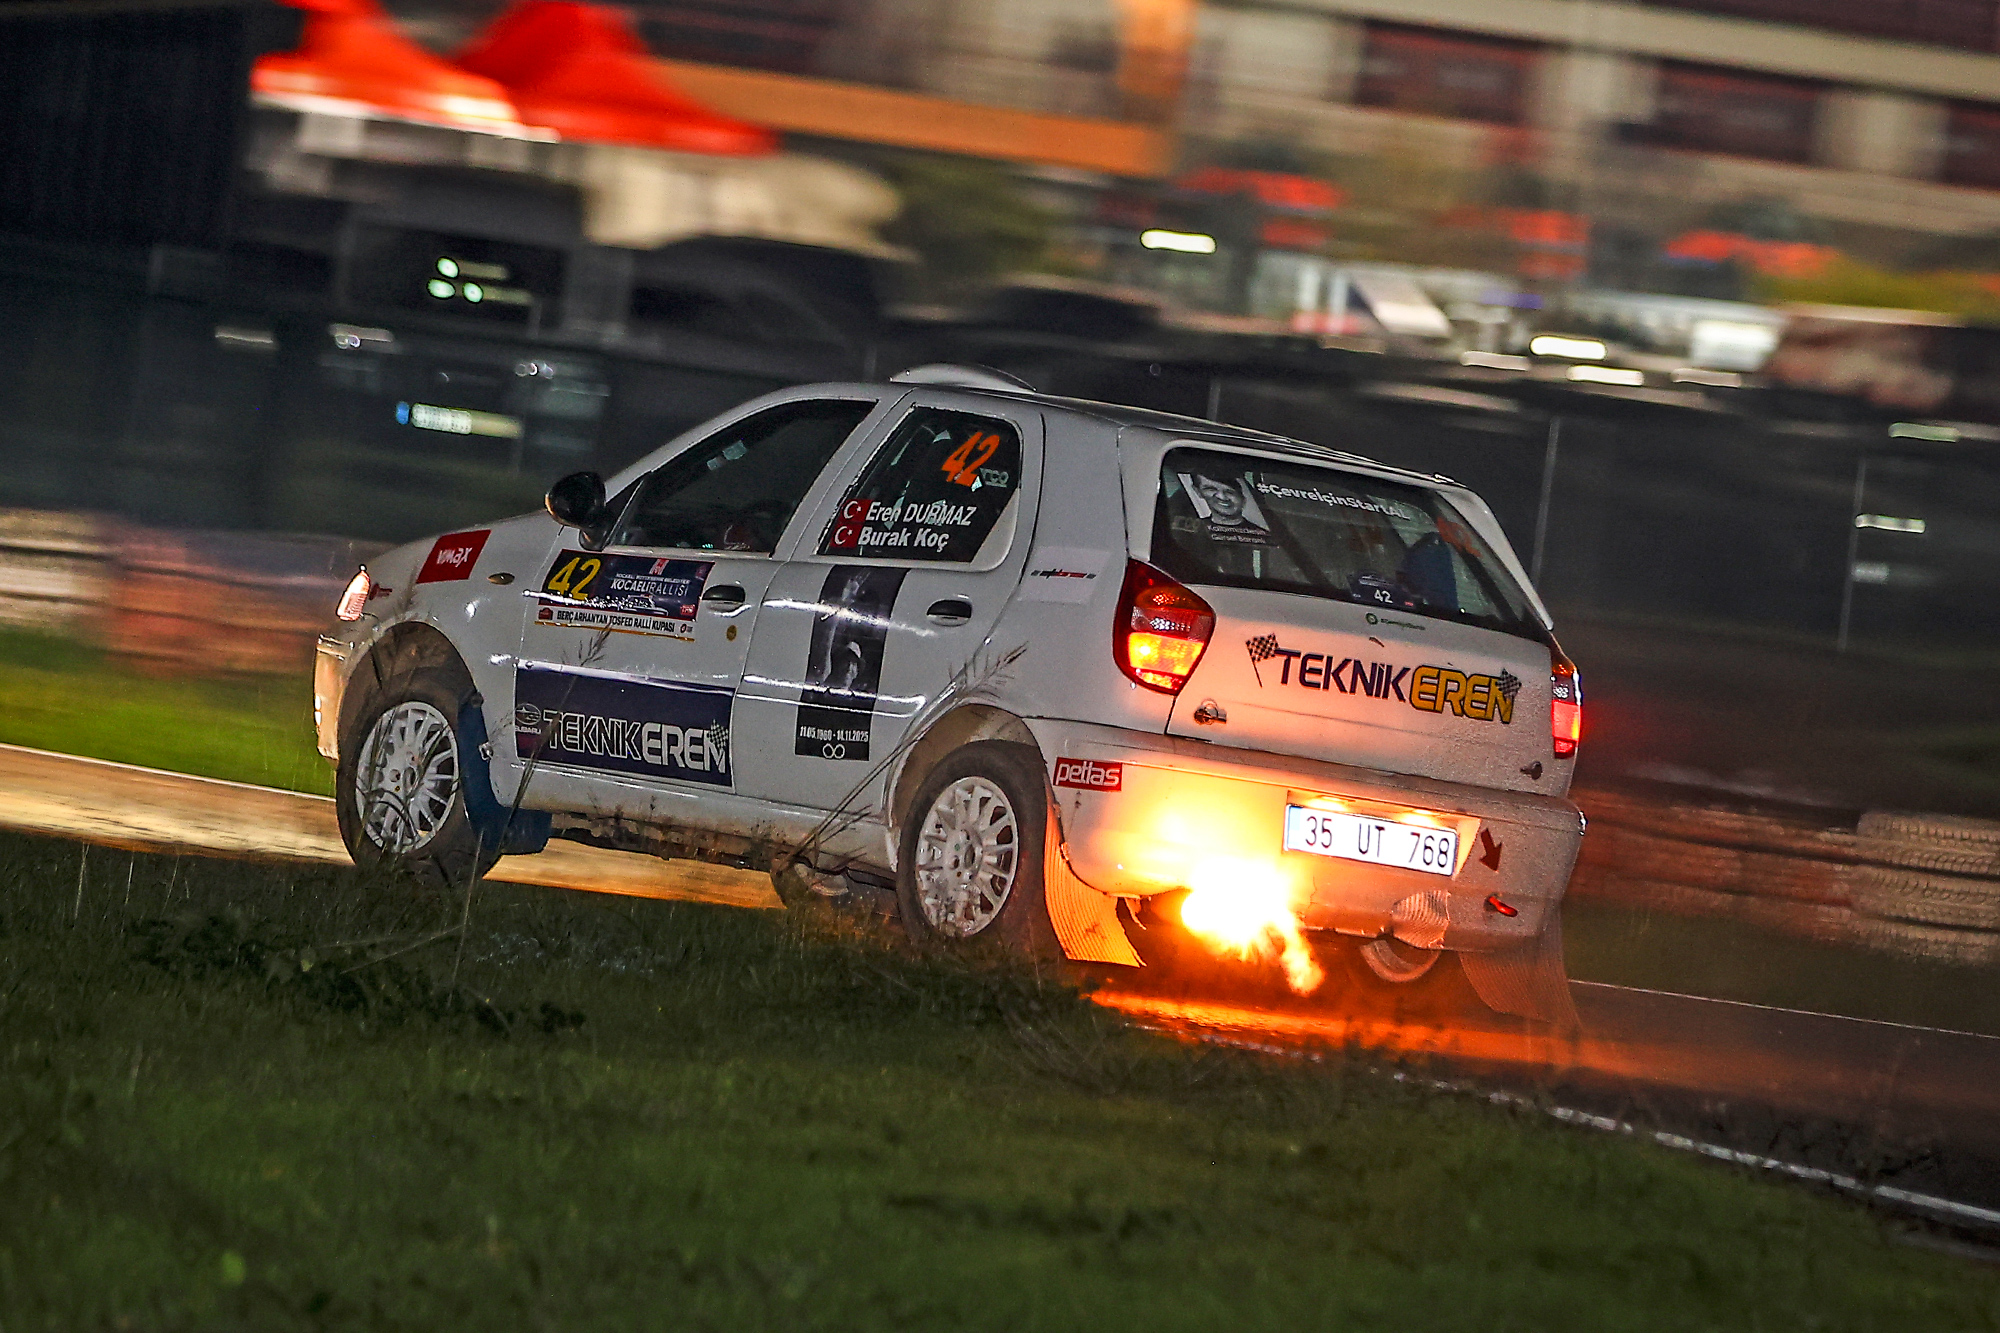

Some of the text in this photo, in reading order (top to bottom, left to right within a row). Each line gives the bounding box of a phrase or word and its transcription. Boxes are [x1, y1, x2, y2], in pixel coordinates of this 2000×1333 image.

[941, 431, 1000, 487] 42
[866, 502, 976, 526] Eren DURMAZ
[858, 526, 950, 552] Burak Koç
[548, 557, 601, 601] 42
[1374, 589, 1394, 604] 42
[1056, 761, 1120, 787] petlas
[1305, 816, 1450, 868] 35 UT 768
